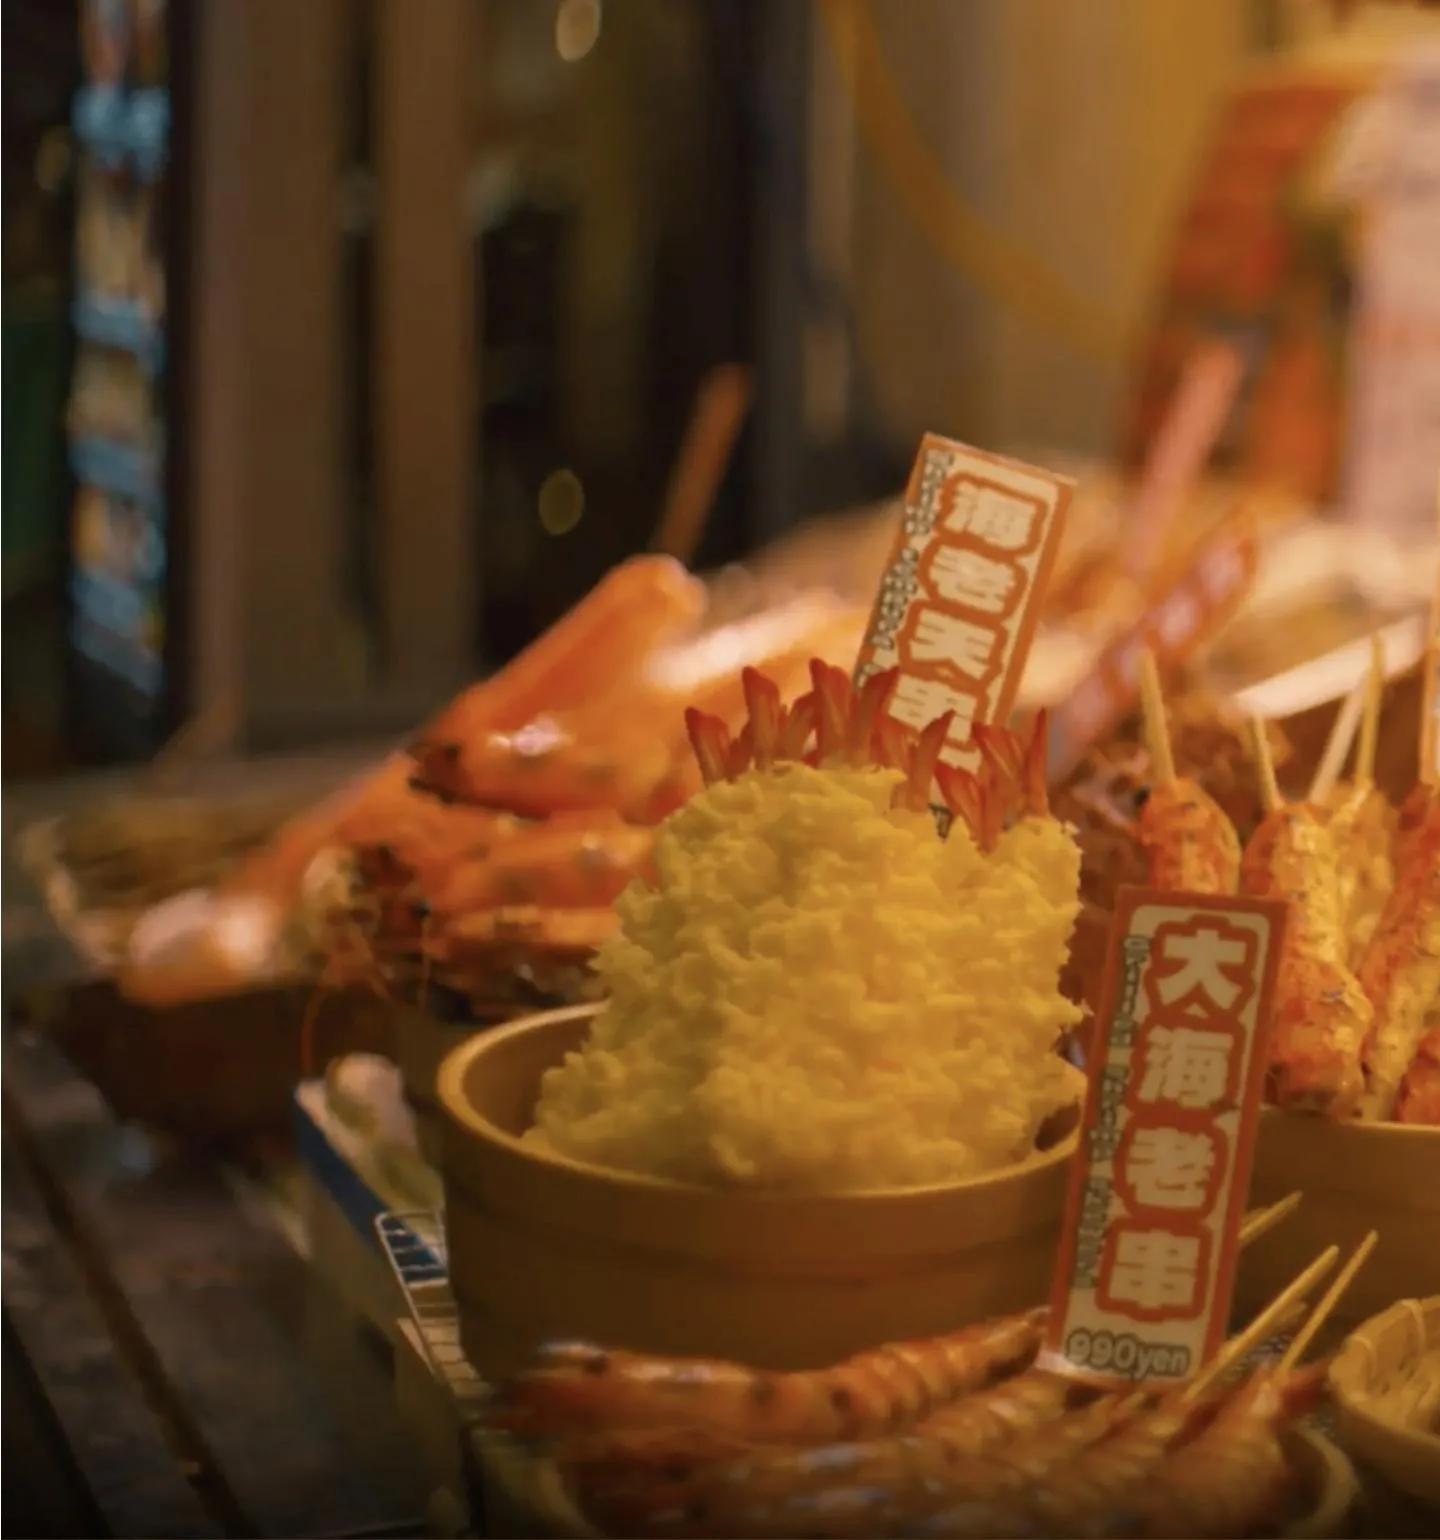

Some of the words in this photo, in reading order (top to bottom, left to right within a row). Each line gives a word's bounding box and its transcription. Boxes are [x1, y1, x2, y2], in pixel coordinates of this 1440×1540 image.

[1103, 923, 1250, 1312] 大海老串
[1066, 1328, 1190, 1380] 990yen
